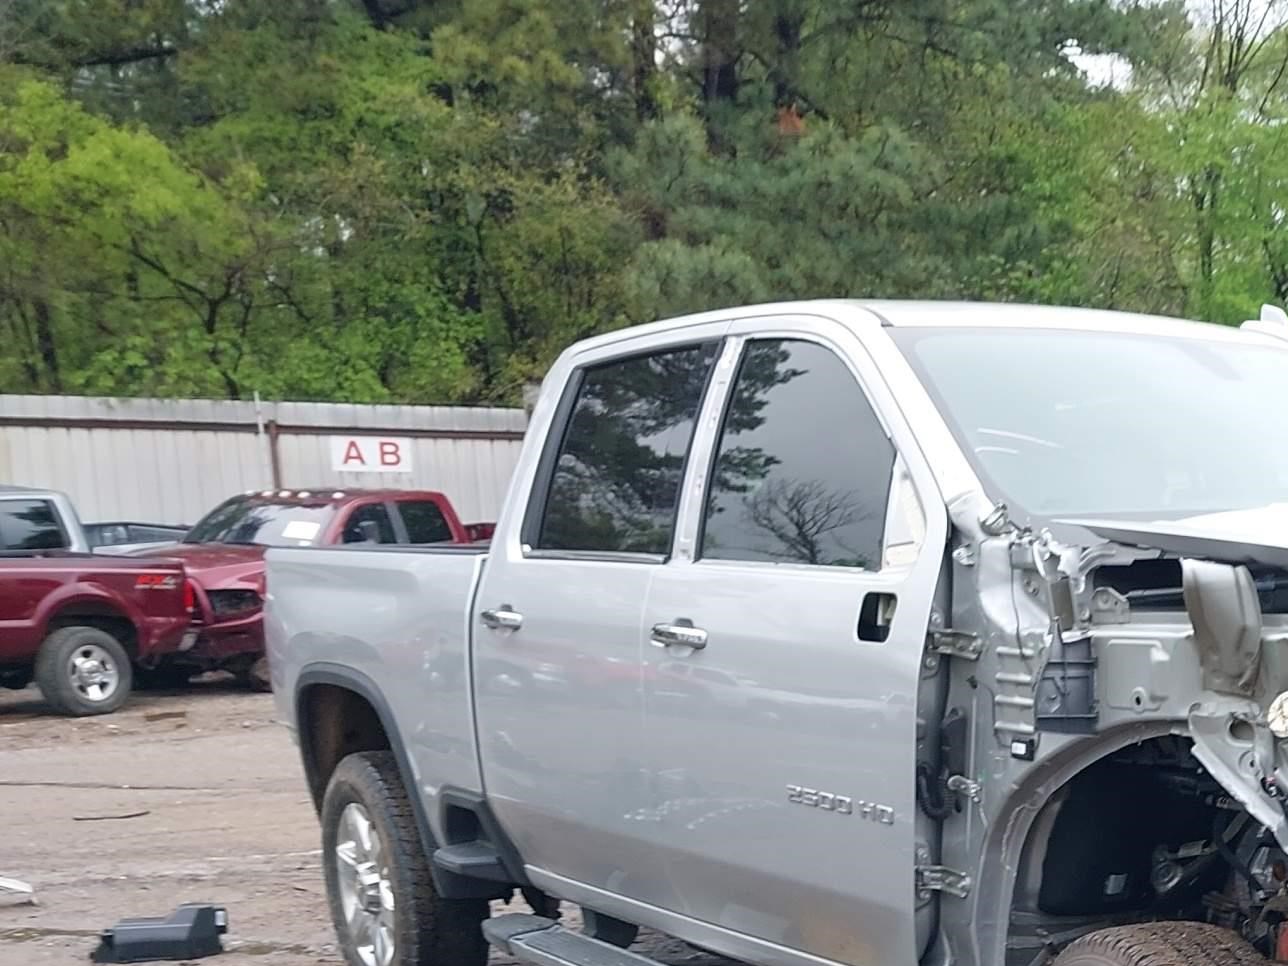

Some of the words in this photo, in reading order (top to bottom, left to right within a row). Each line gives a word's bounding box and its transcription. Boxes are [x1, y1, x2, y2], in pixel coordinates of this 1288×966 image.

[343, 440, 366, 465] A
[379, 441, 401, 466] B
[786, 784, 853, 815] 2500
[859, 800, 895, 826] HD
